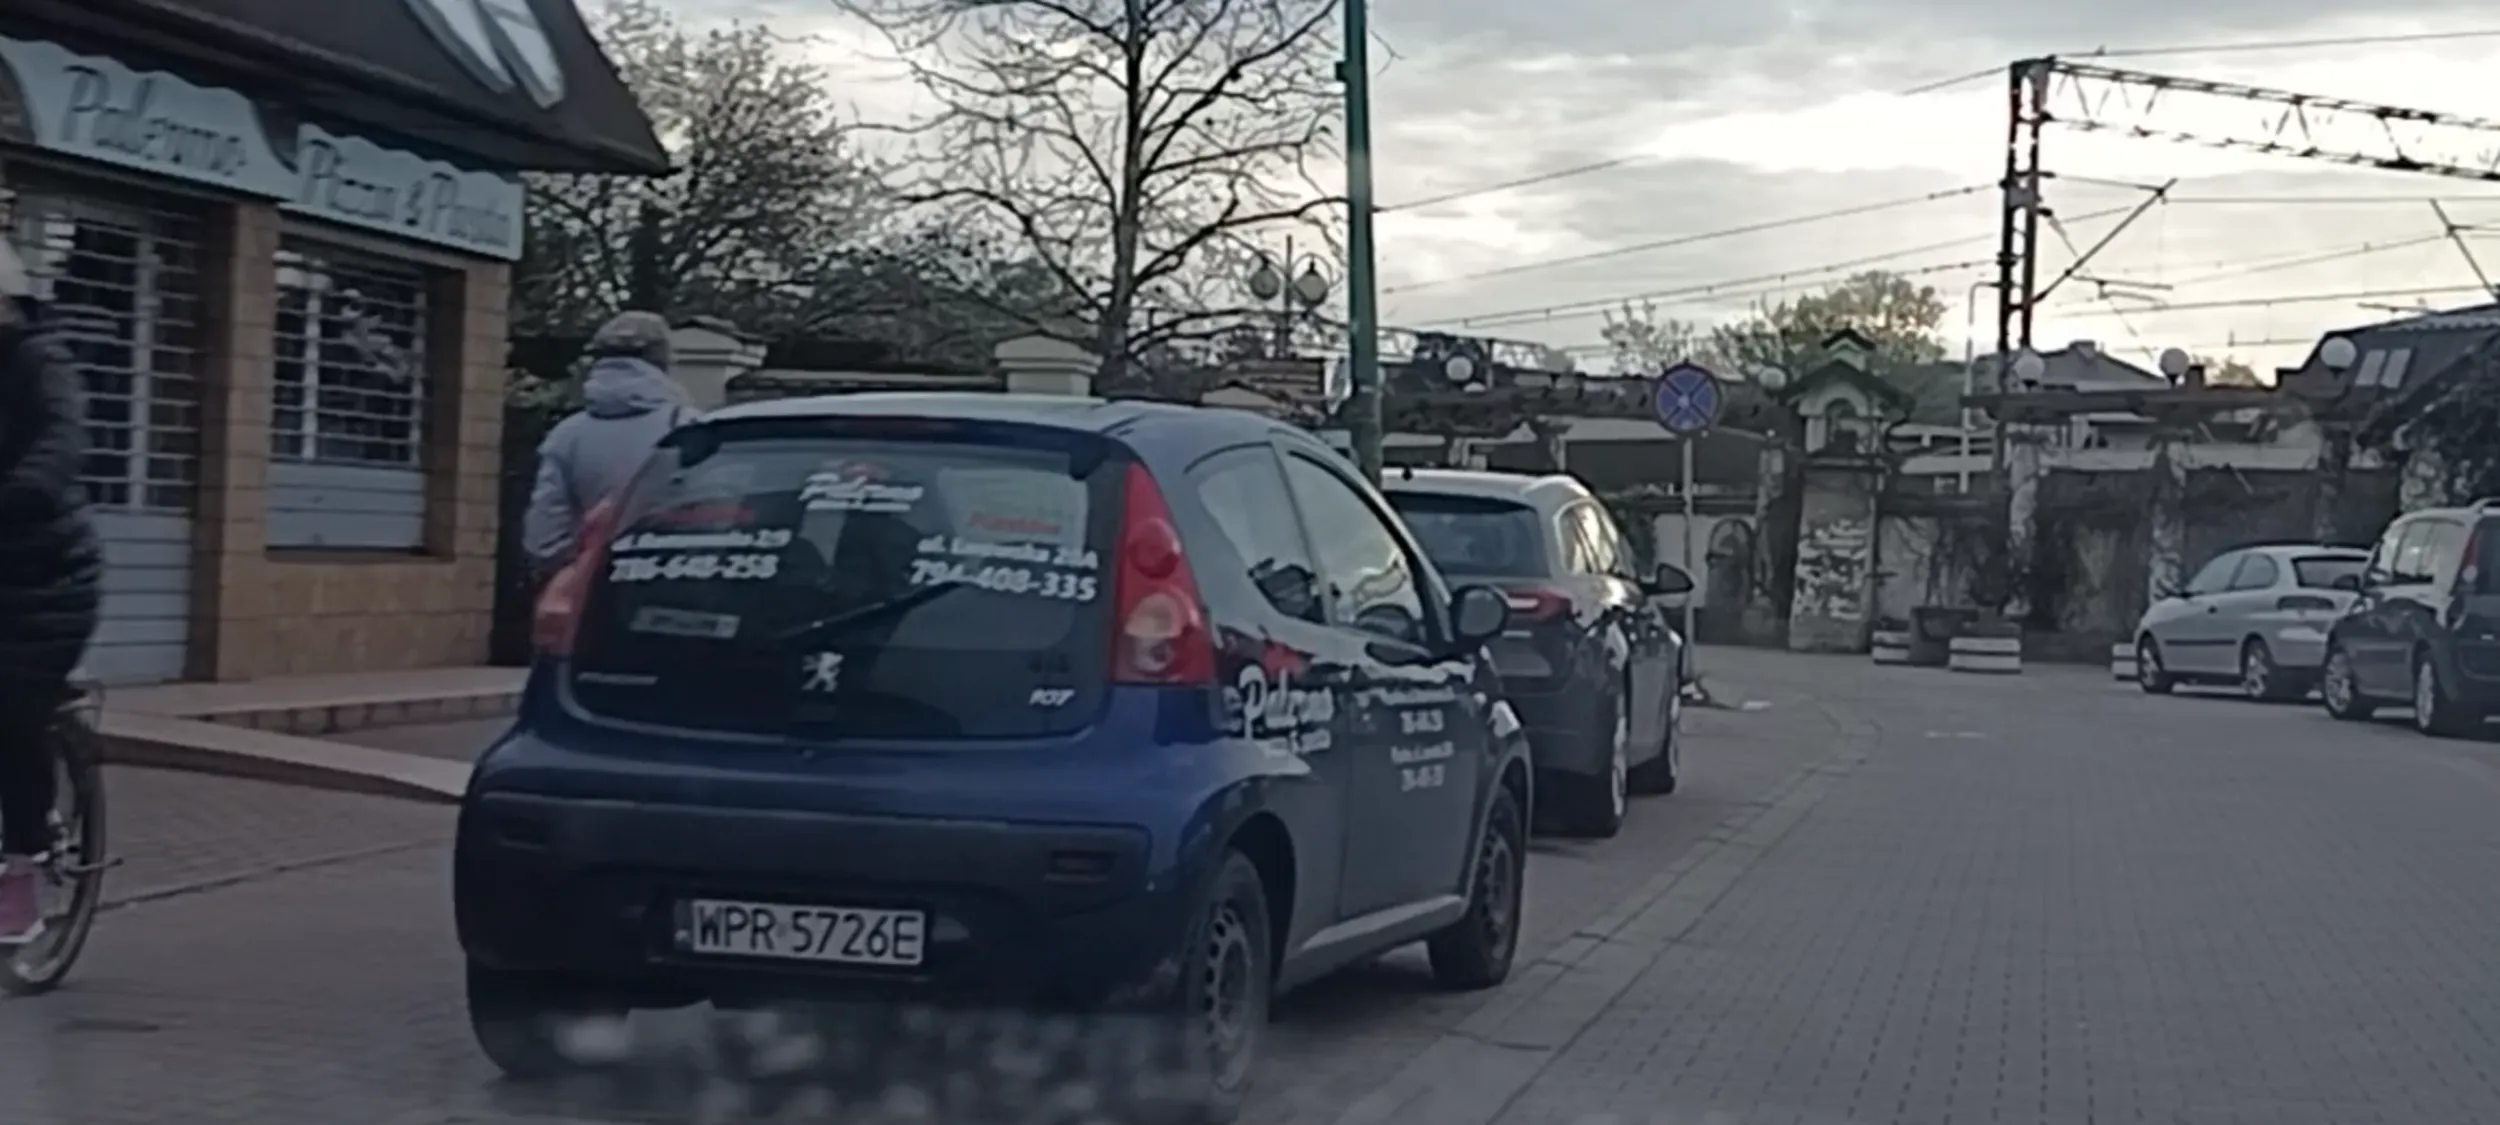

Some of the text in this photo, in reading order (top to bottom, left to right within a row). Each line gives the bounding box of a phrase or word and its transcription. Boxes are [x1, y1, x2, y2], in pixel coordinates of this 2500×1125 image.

[1028, 688, 1076, 707] 107
[699, 903, 920, 961] WPR 5726E
